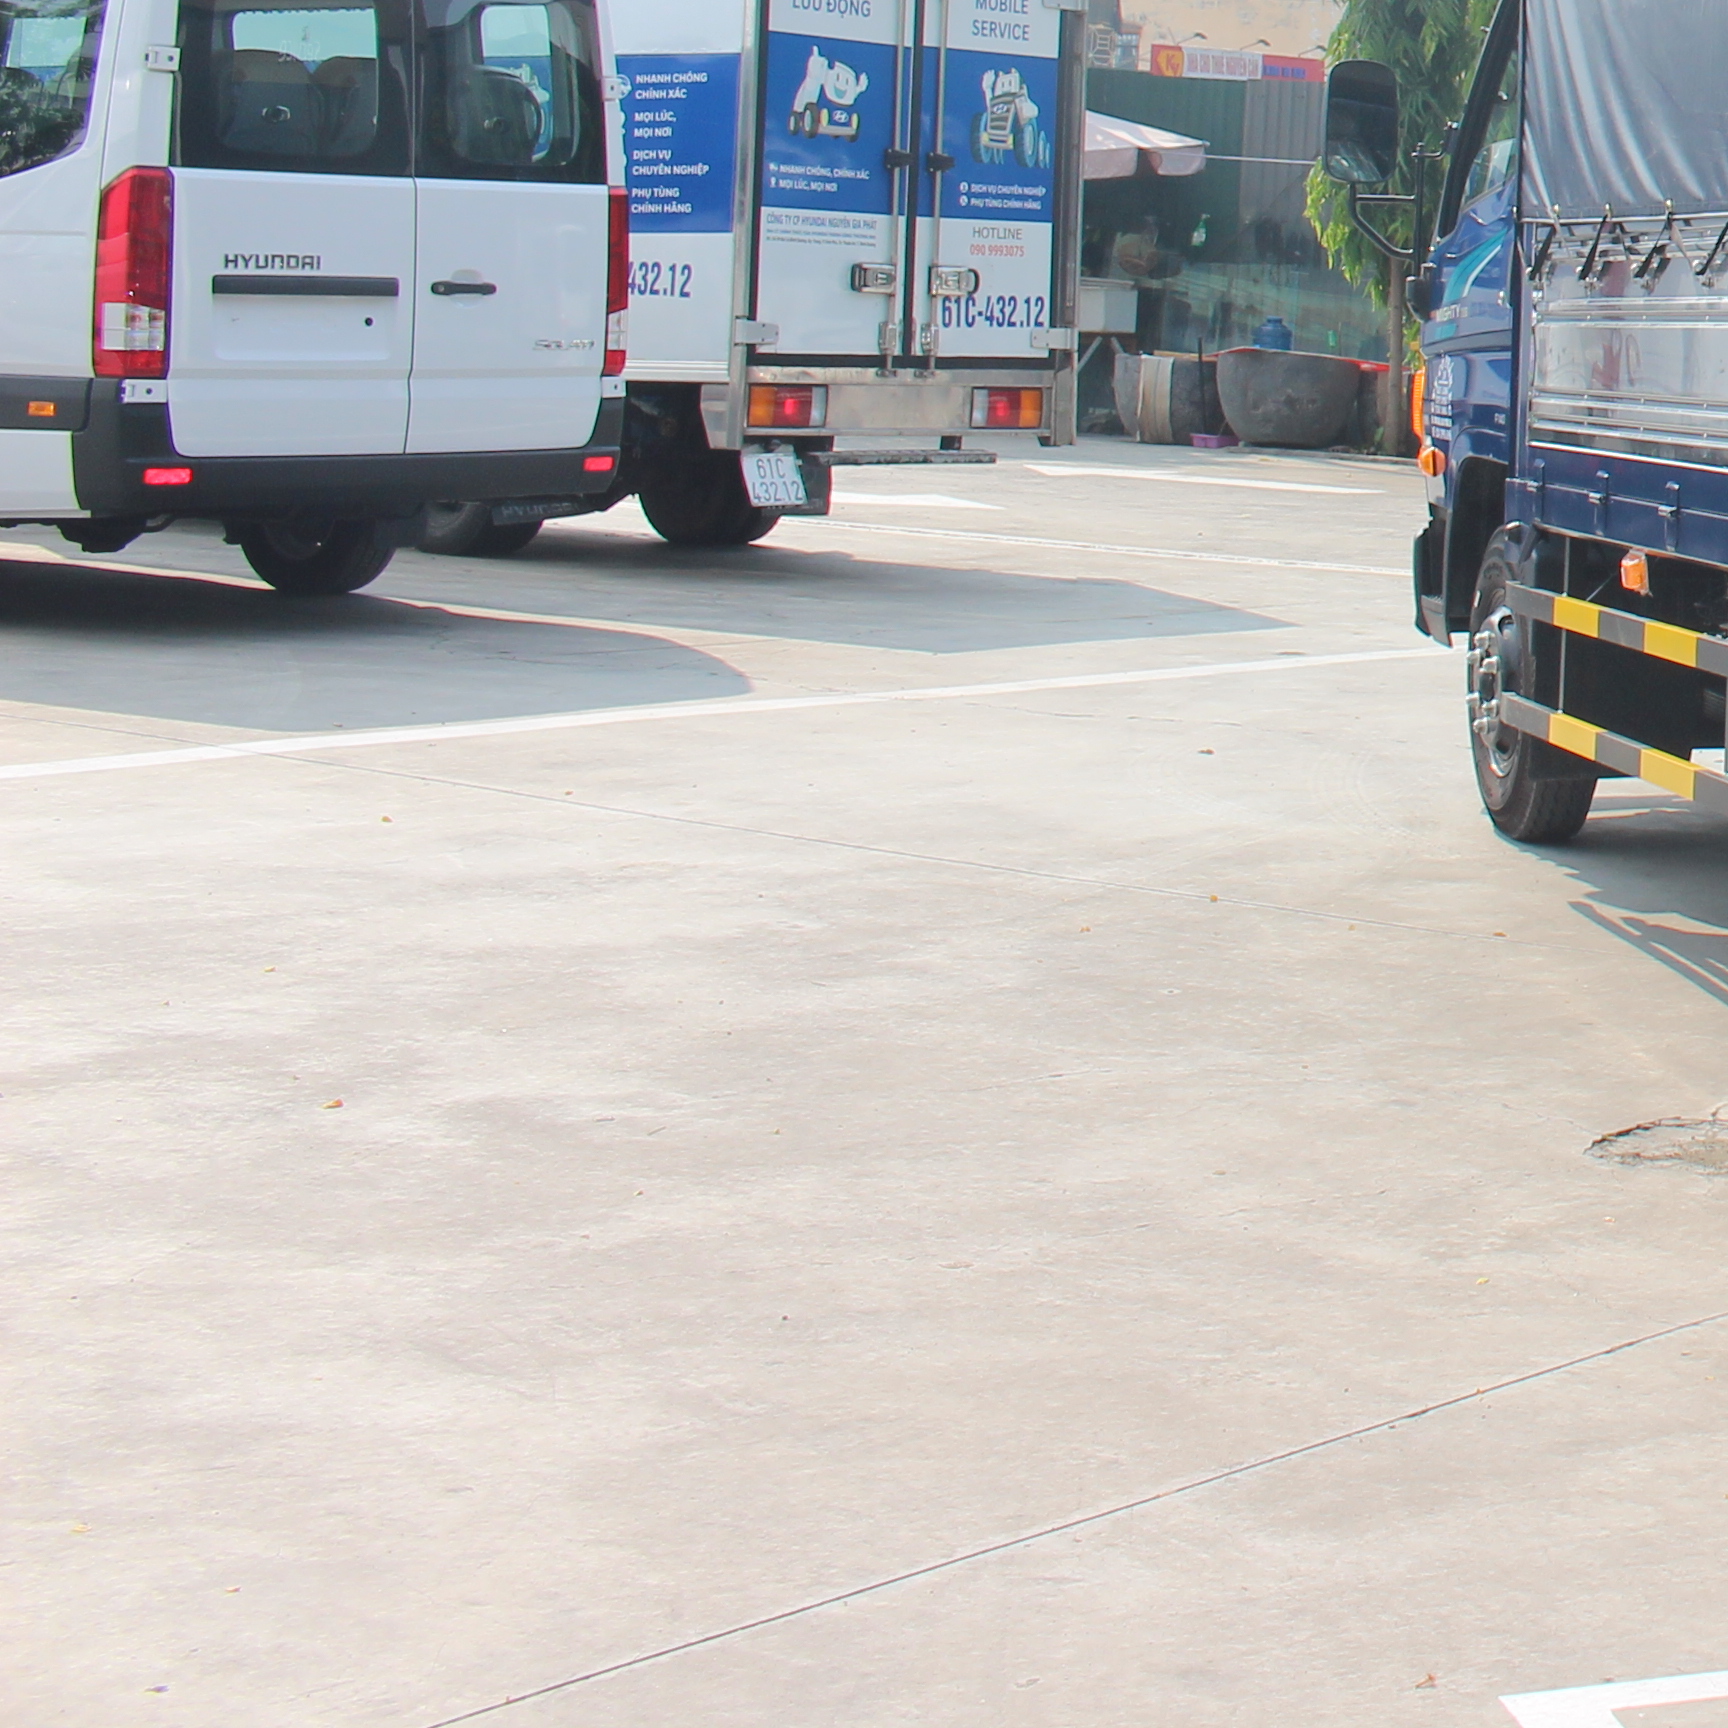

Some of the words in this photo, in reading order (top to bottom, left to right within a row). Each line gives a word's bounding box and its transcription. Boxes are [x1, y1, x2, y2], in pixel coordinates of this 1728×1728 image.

[972, 19, 1030, 41] SERVICE
[636, 74, 671, 84] NHANH
[673, 71, 708, 83] CHÓNG
[635, 87, 667, 100] CHÍNH
[668, 87, 688, 99] XÁC
[634, 112, 654, 124] MỌI
[655, 109, 677, 122] LÚC,
[634, 128, 653, 139] MỌI
[654, 126, 672, 137] NƠI
[633, 150, 657, 161] DỊCH
[658, 150, 672, 161] VỤ
[632, 163, 672, 176] CHUYÊN
[673, 163, 709, 176] NGHIỆP
[631, 188, 652, 199] PHỤ
[653, 186, 680, 197] TÙNG
[631, 202, 663, 213] CHÍNH
[664, 201, 692, 213] HÃNG
[972, 227, 1022, 240] HOTLINE
[970, 244, 986, 256] 090
[224, 254, 321, 270] HYUNDAI
[942, 295, 1045, 328] 61C-432.12
[756, 458, 786, 479] 61C
